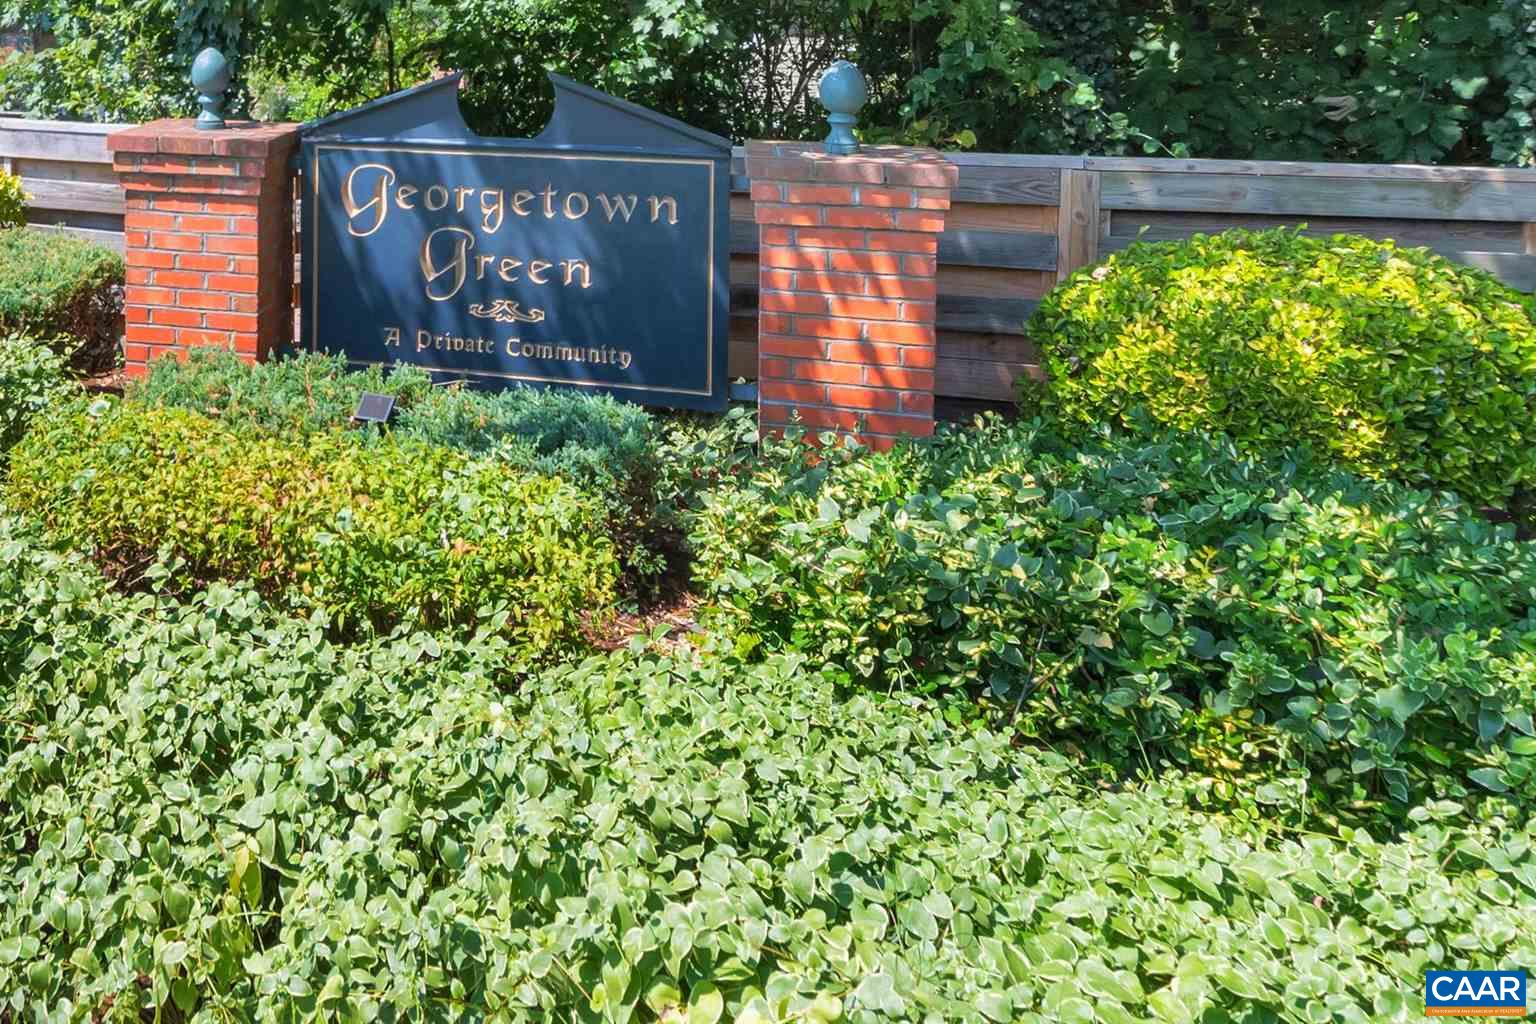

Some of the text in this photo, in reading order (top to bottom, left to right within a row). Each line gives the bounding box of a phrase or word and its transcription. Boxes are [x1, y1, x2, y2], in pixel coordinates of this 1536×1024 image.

[340, 163, 680, 238] Georgetown
[419, 226, 593, 302] Green
[383, 327, 633, 370] A Private Community
